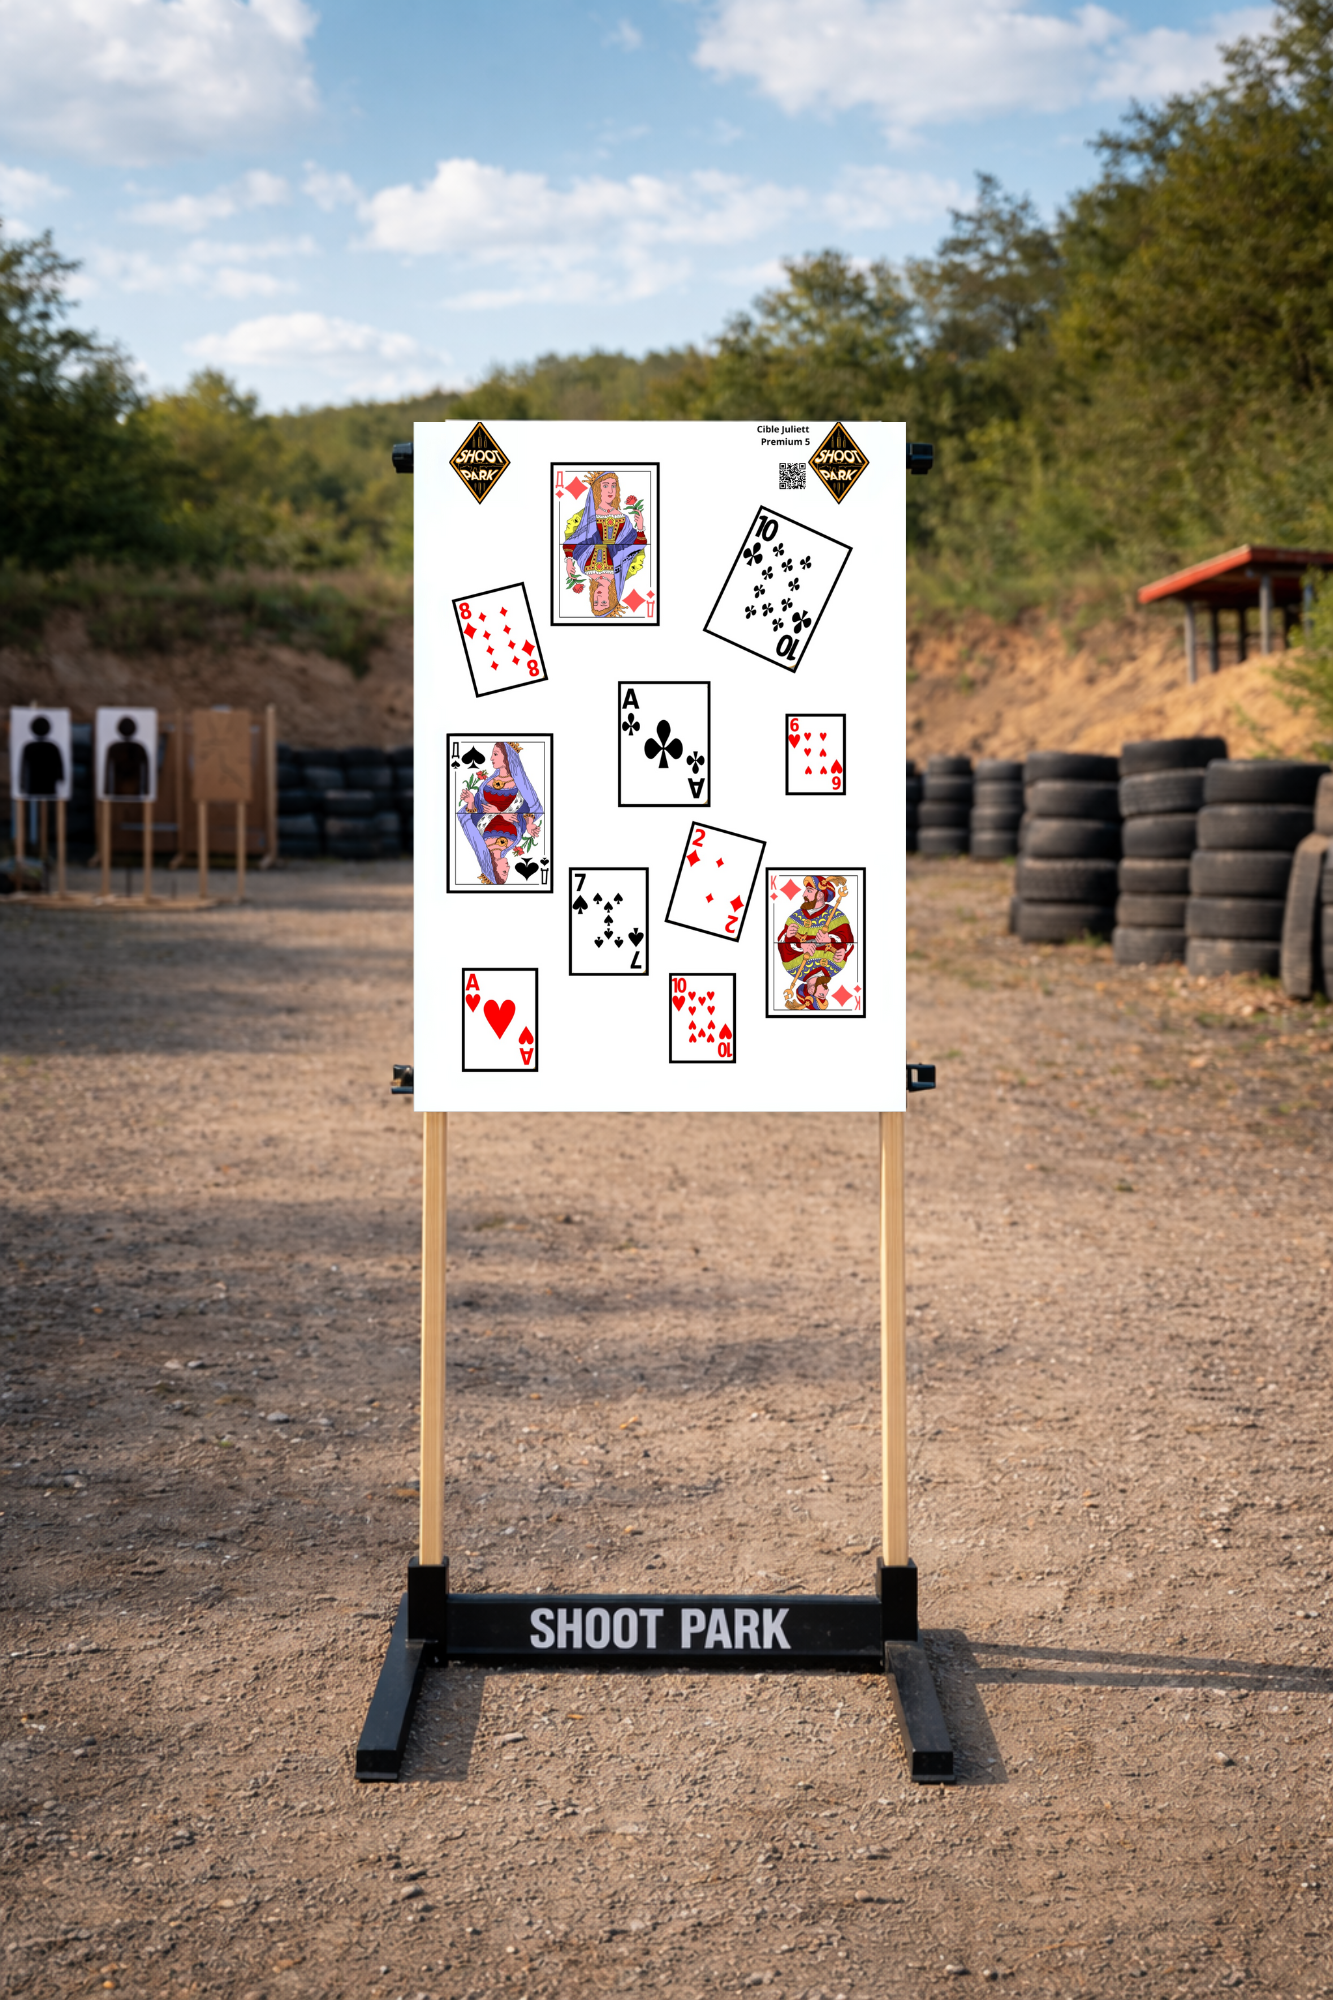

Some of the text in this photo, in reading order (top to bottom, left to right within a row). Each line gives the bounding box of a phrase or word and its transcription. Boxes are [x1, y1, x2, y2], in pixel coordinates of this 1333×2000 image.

[757, 425, 810, 435] Cible Juliett
[761, 438, 811, 446] Premium 5
[455, 449, 504, 463] SHOOT
[814, 449, 863, 463] SHOOT
[460, 469, 499, 481] PARK
[819, 469, 858, 481] PARK
[755, 515, 779, 541] 10
[458, 602, 472, 620] 8
[775, 634, 800, 661] 10
[526, 659, 540, 677] 8
[621, 688, 640, 710] A
[790, 718, 799, 732] 6
[688, 778, 705, 798] A
[692, 829, 705, 847] 2
[574, 873, 587, 892] 7
[724, 914, 738, 934] 2
[630, 951, 642, 970] 7
[465, 973, 480, 991] A
[672, 977, 687, 993] 10
[519, 1048, 534, 1065] A
[717, 1041, 732, 1058] 10
[530, 1607, 792, 1649] SHOOT PARK
